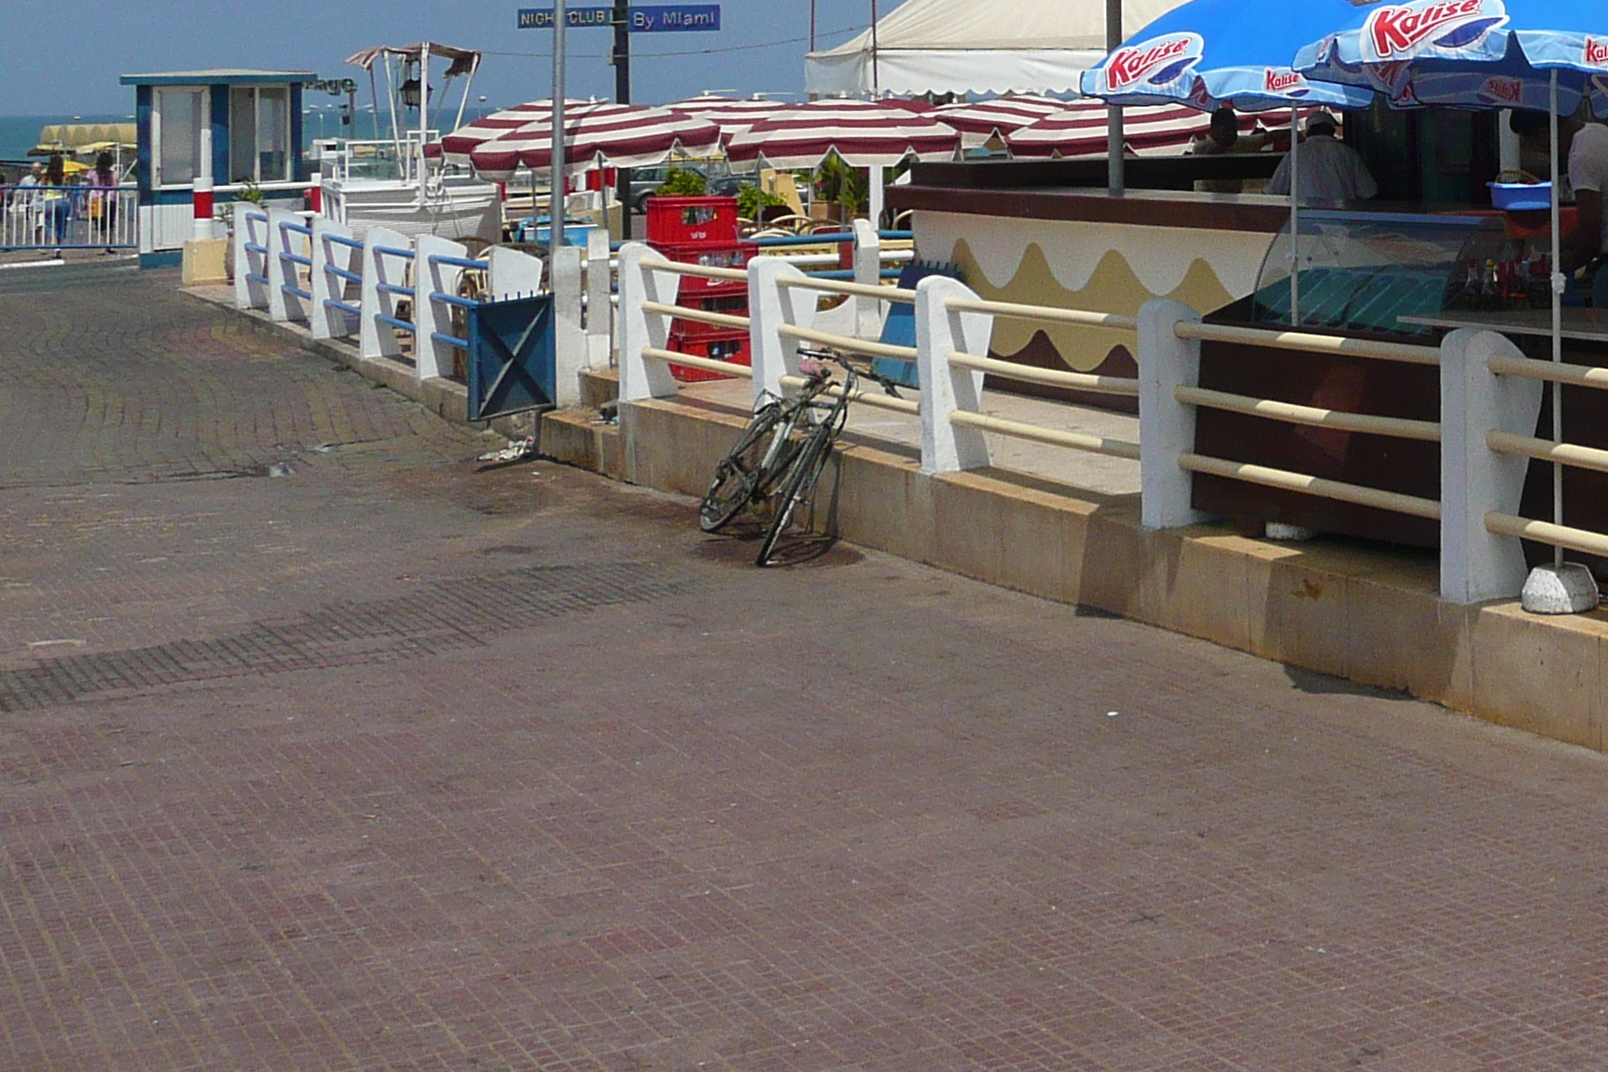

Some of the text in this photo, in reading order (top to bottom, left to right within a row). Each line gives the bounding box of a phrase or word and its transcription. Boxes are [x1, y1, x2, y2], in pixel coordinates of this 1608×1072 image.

[568, 10, 605, 24] CLUB
[632, 11, 654, 29] By
[1107, 38, 1191, 89] Kalise
[1265, 70, 1300, 91] Kalise
